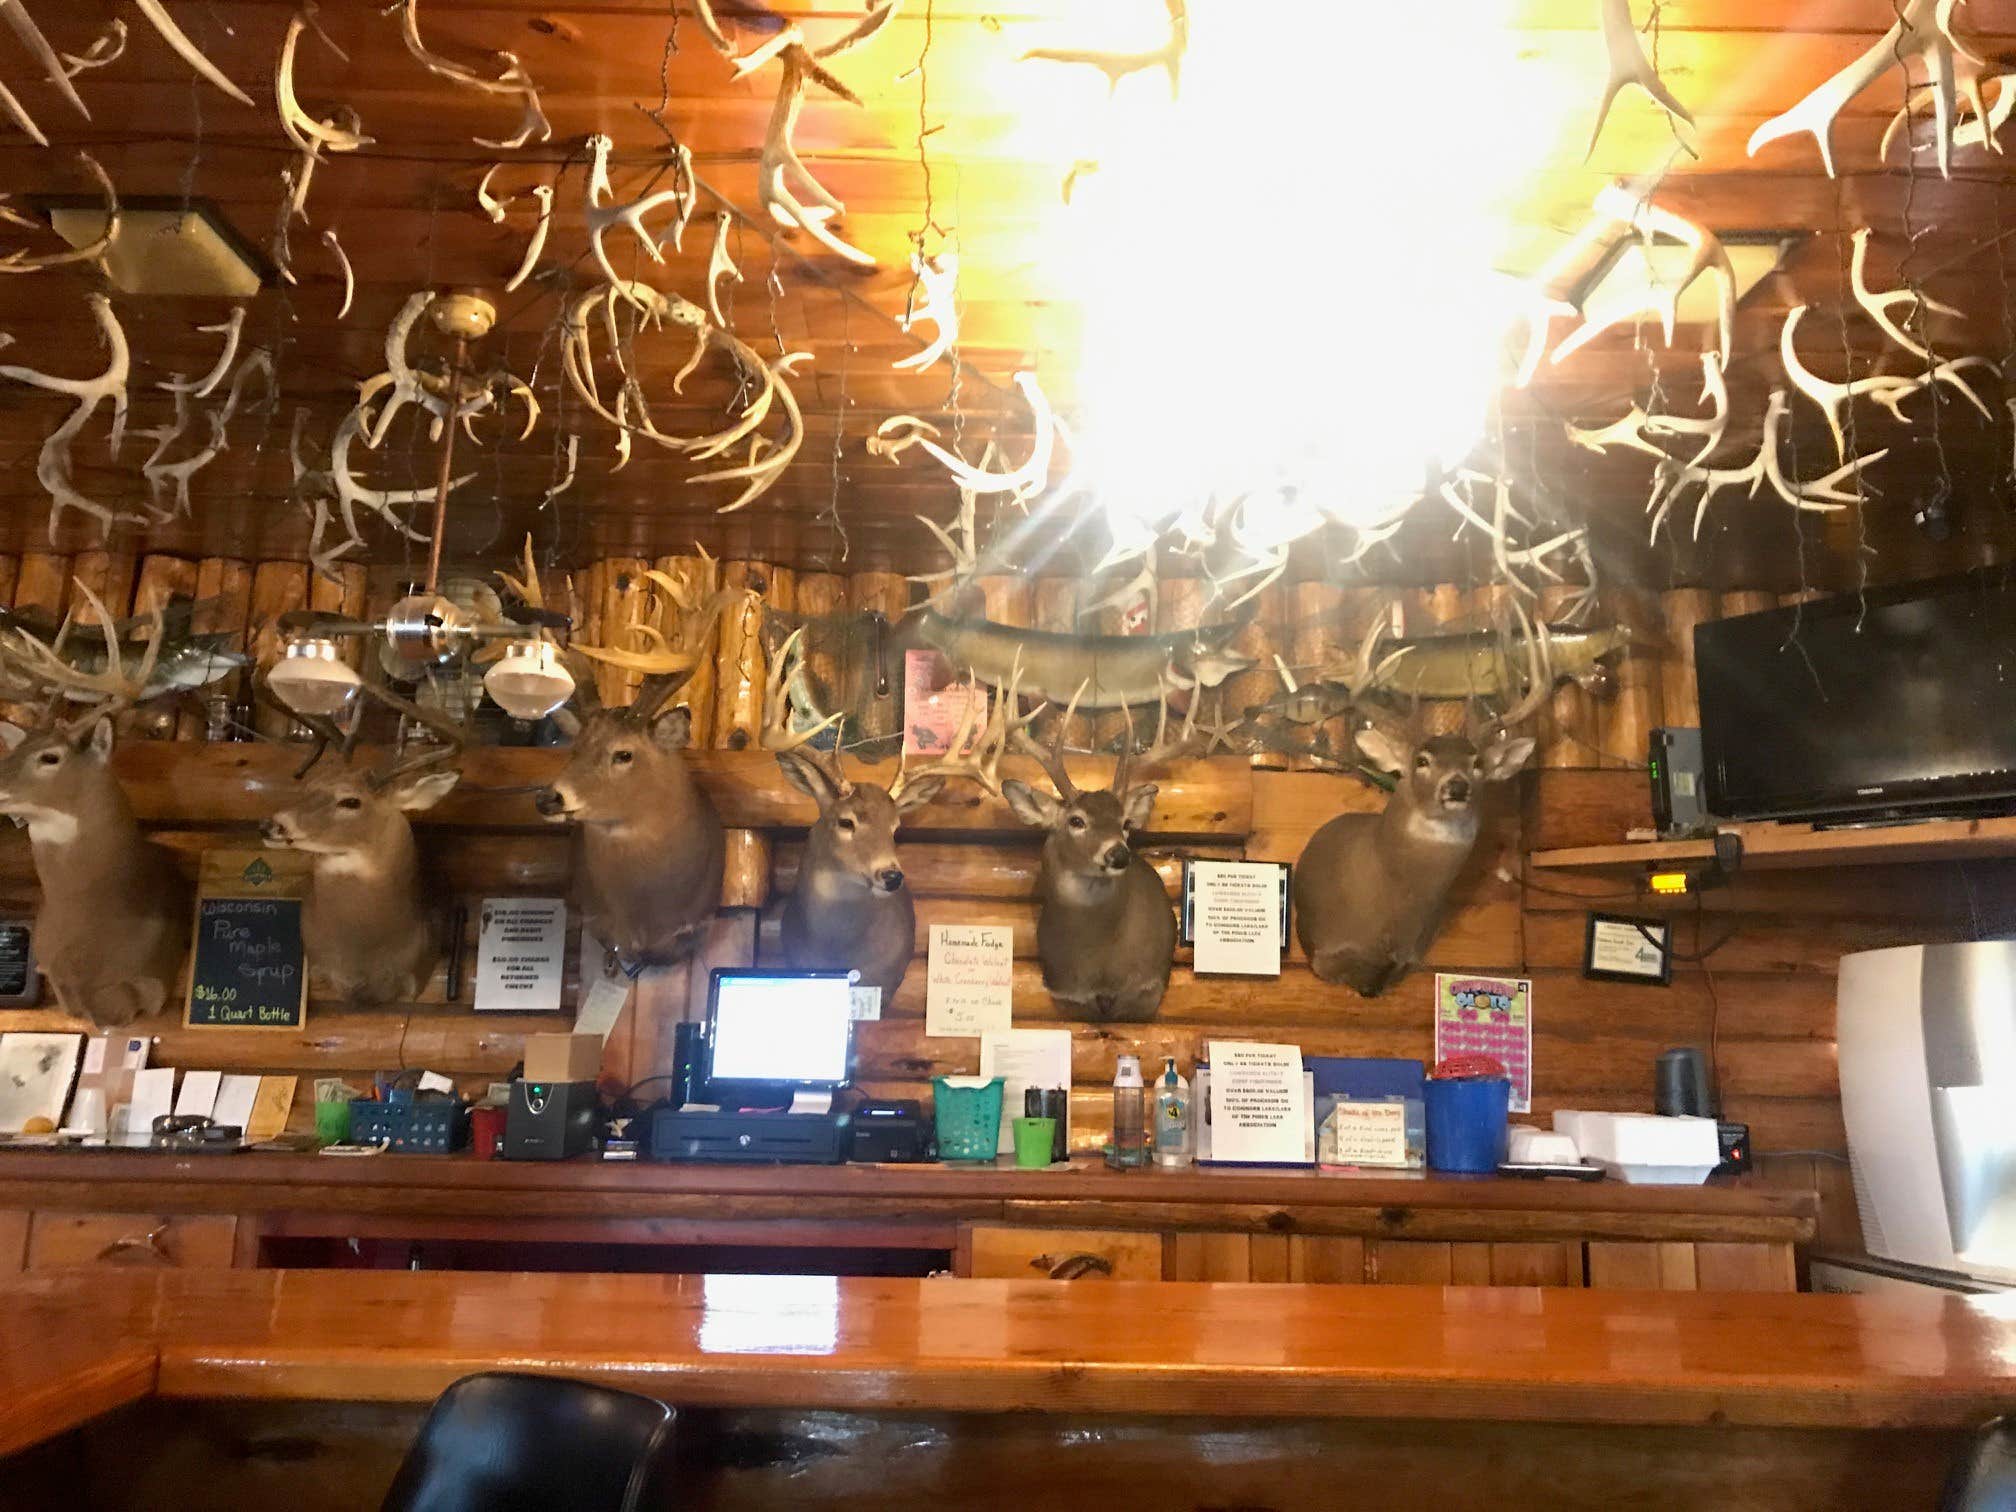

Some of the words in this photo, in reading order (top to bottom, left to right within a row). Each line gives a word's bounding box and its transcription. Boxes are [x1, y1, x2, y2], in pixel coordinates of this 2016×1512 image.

[213, 918, 250, 940] Pure
[940, 928, 978, 948] Homemade
[981, 931, 1004, 950] Fudge
[207, 1005, 217, 1020] 1
[220, 1005, 254, 1021] Quart
[258, 1005, 291, 1022] Bottle
